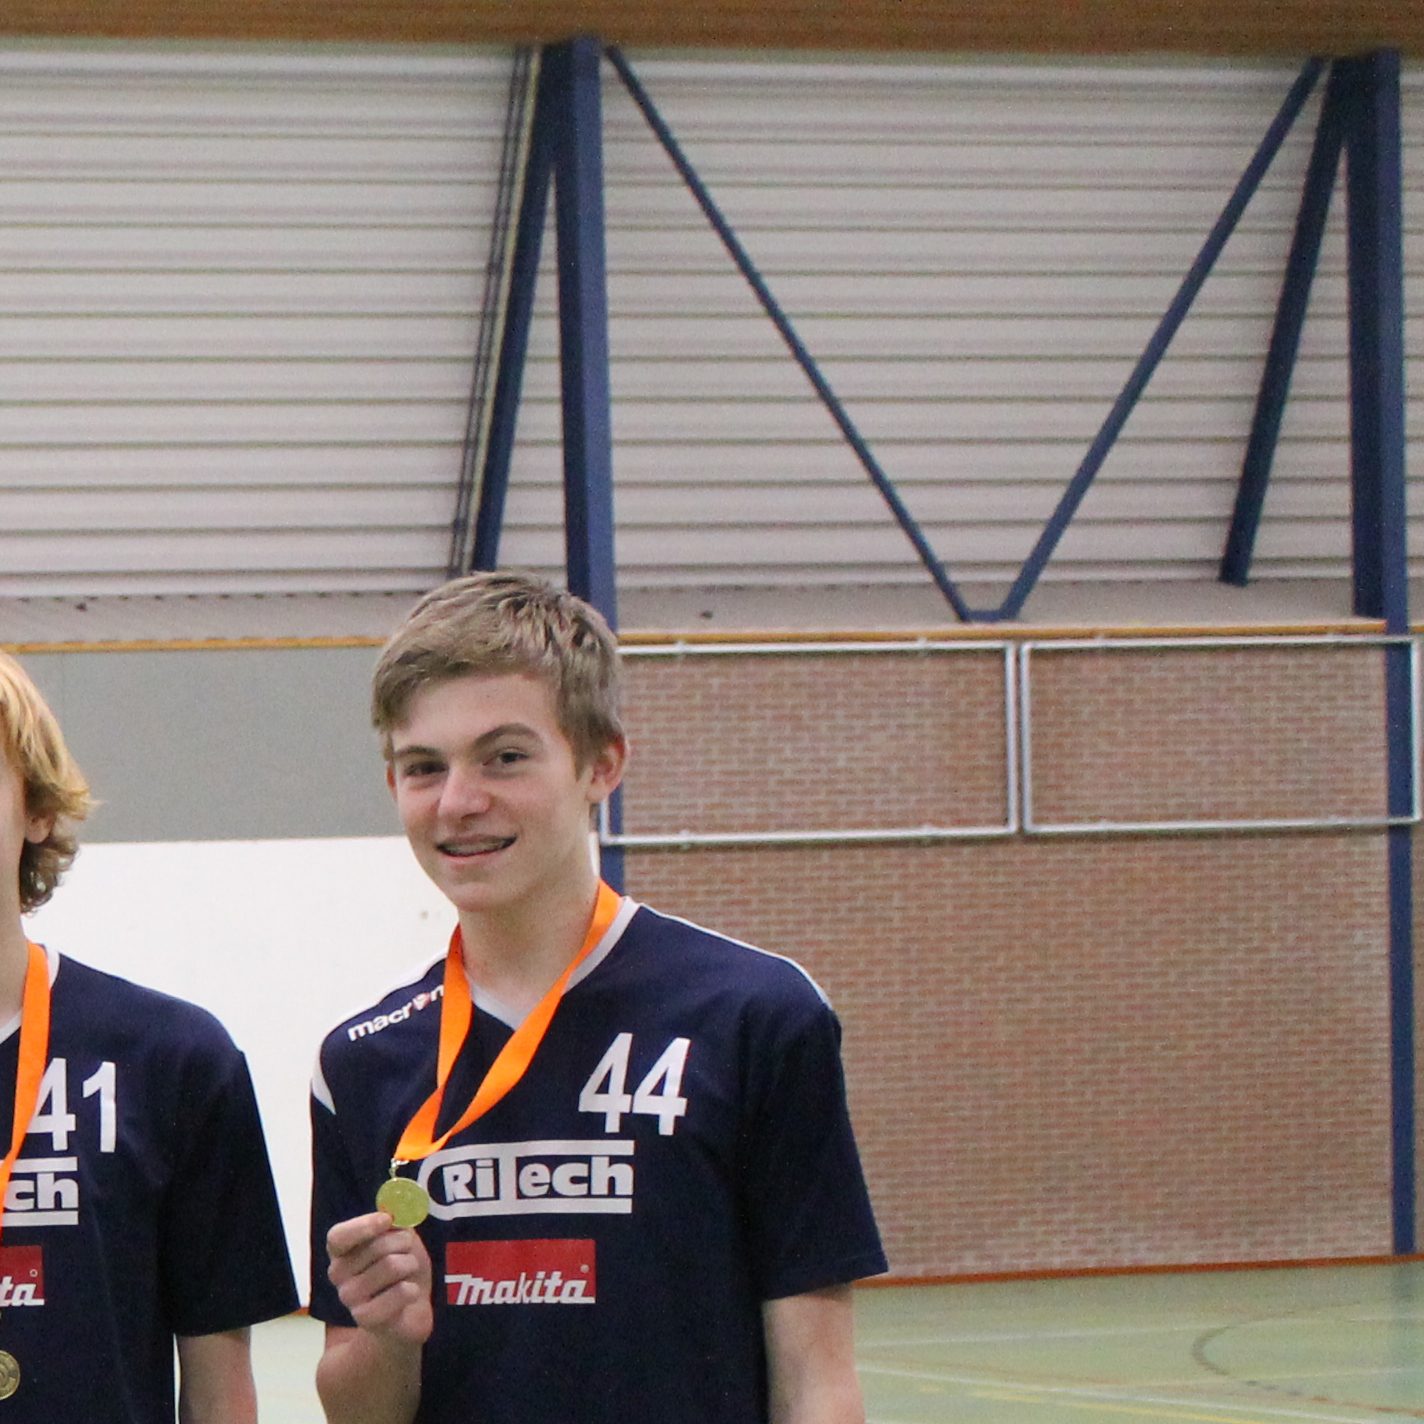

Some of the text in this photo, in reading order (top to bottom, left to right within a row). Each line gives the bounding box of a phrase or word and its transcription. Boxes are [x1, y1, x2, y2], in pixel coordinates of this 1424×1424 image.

[347, 984, 444, 1041] macron
[25, 1057, 117, 1153] 41
[578, 1032, 691, 1136] 44
